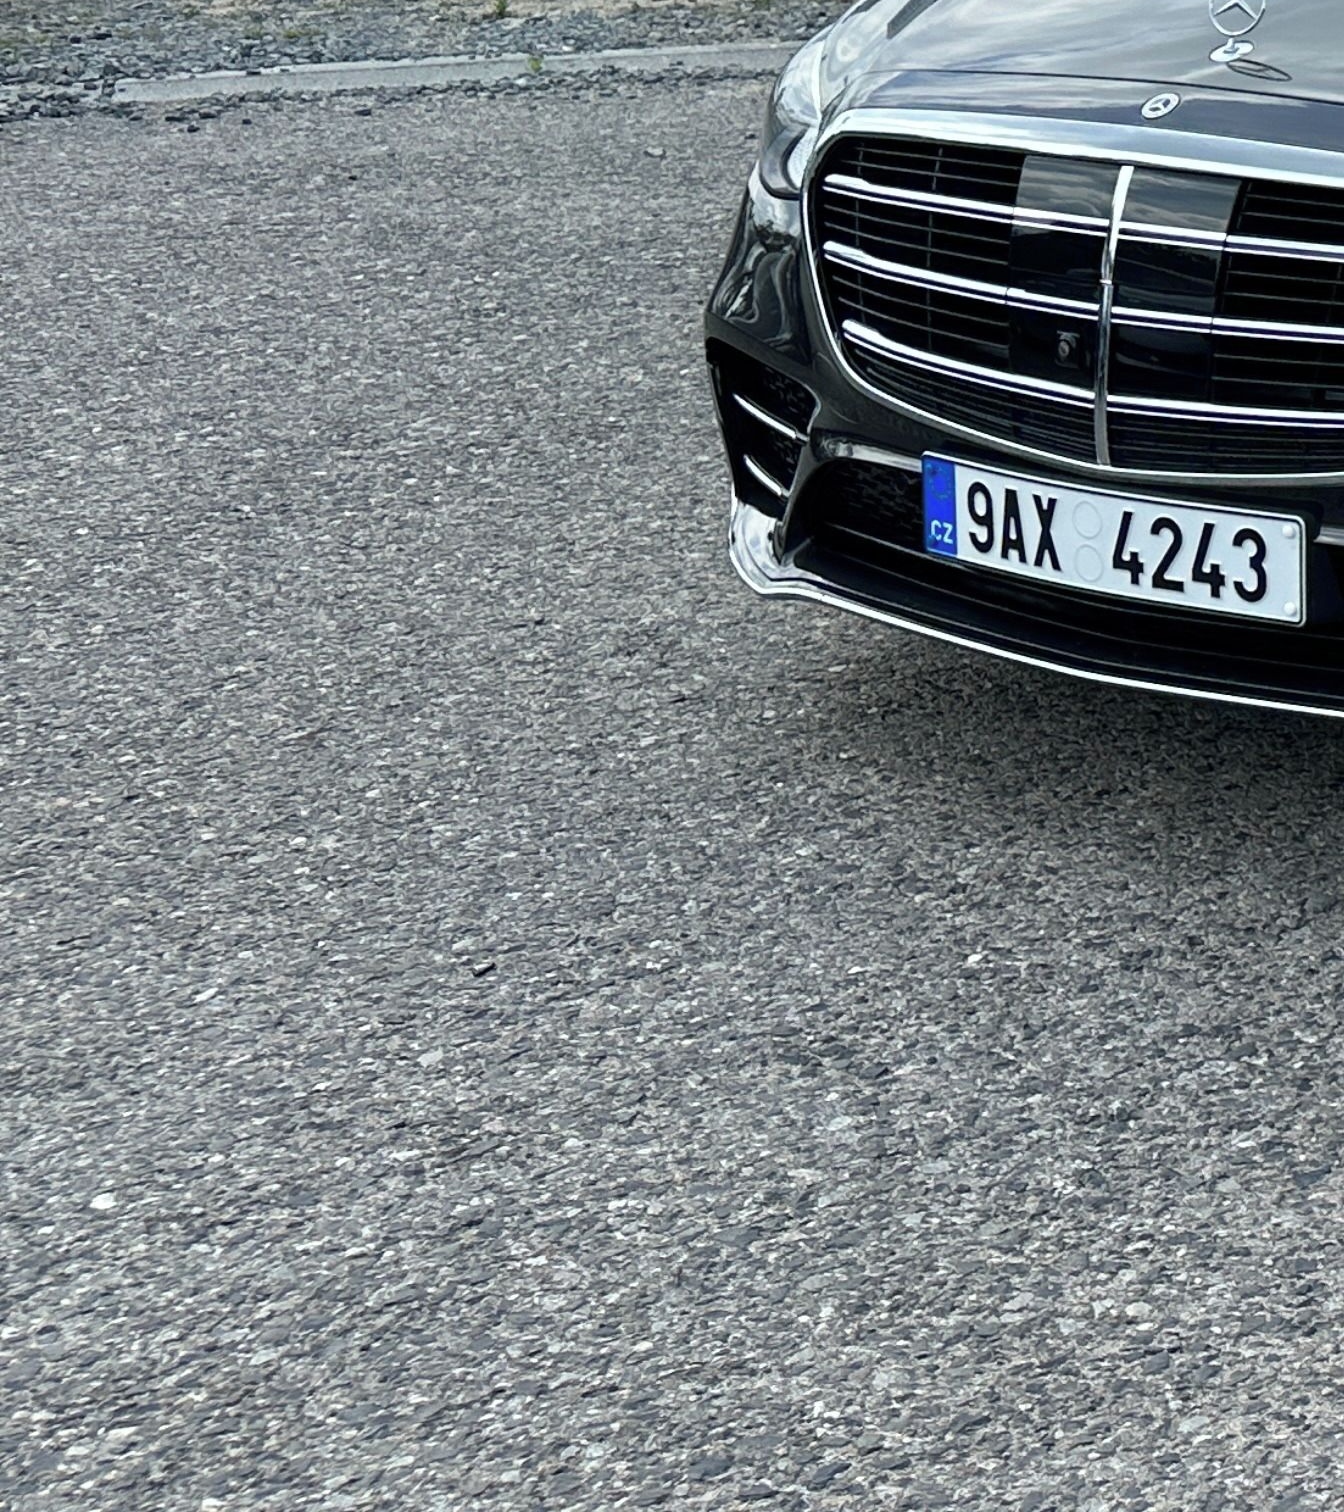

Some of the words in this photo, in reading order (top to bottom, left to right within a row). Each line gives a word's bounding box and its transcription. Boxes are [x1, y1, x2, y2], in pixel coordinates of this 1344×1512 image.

[929, 518, 954, 545] CZ
[967, 481, 1062, 573] 9AX
[1111, 510, 1268, 603] 4243
